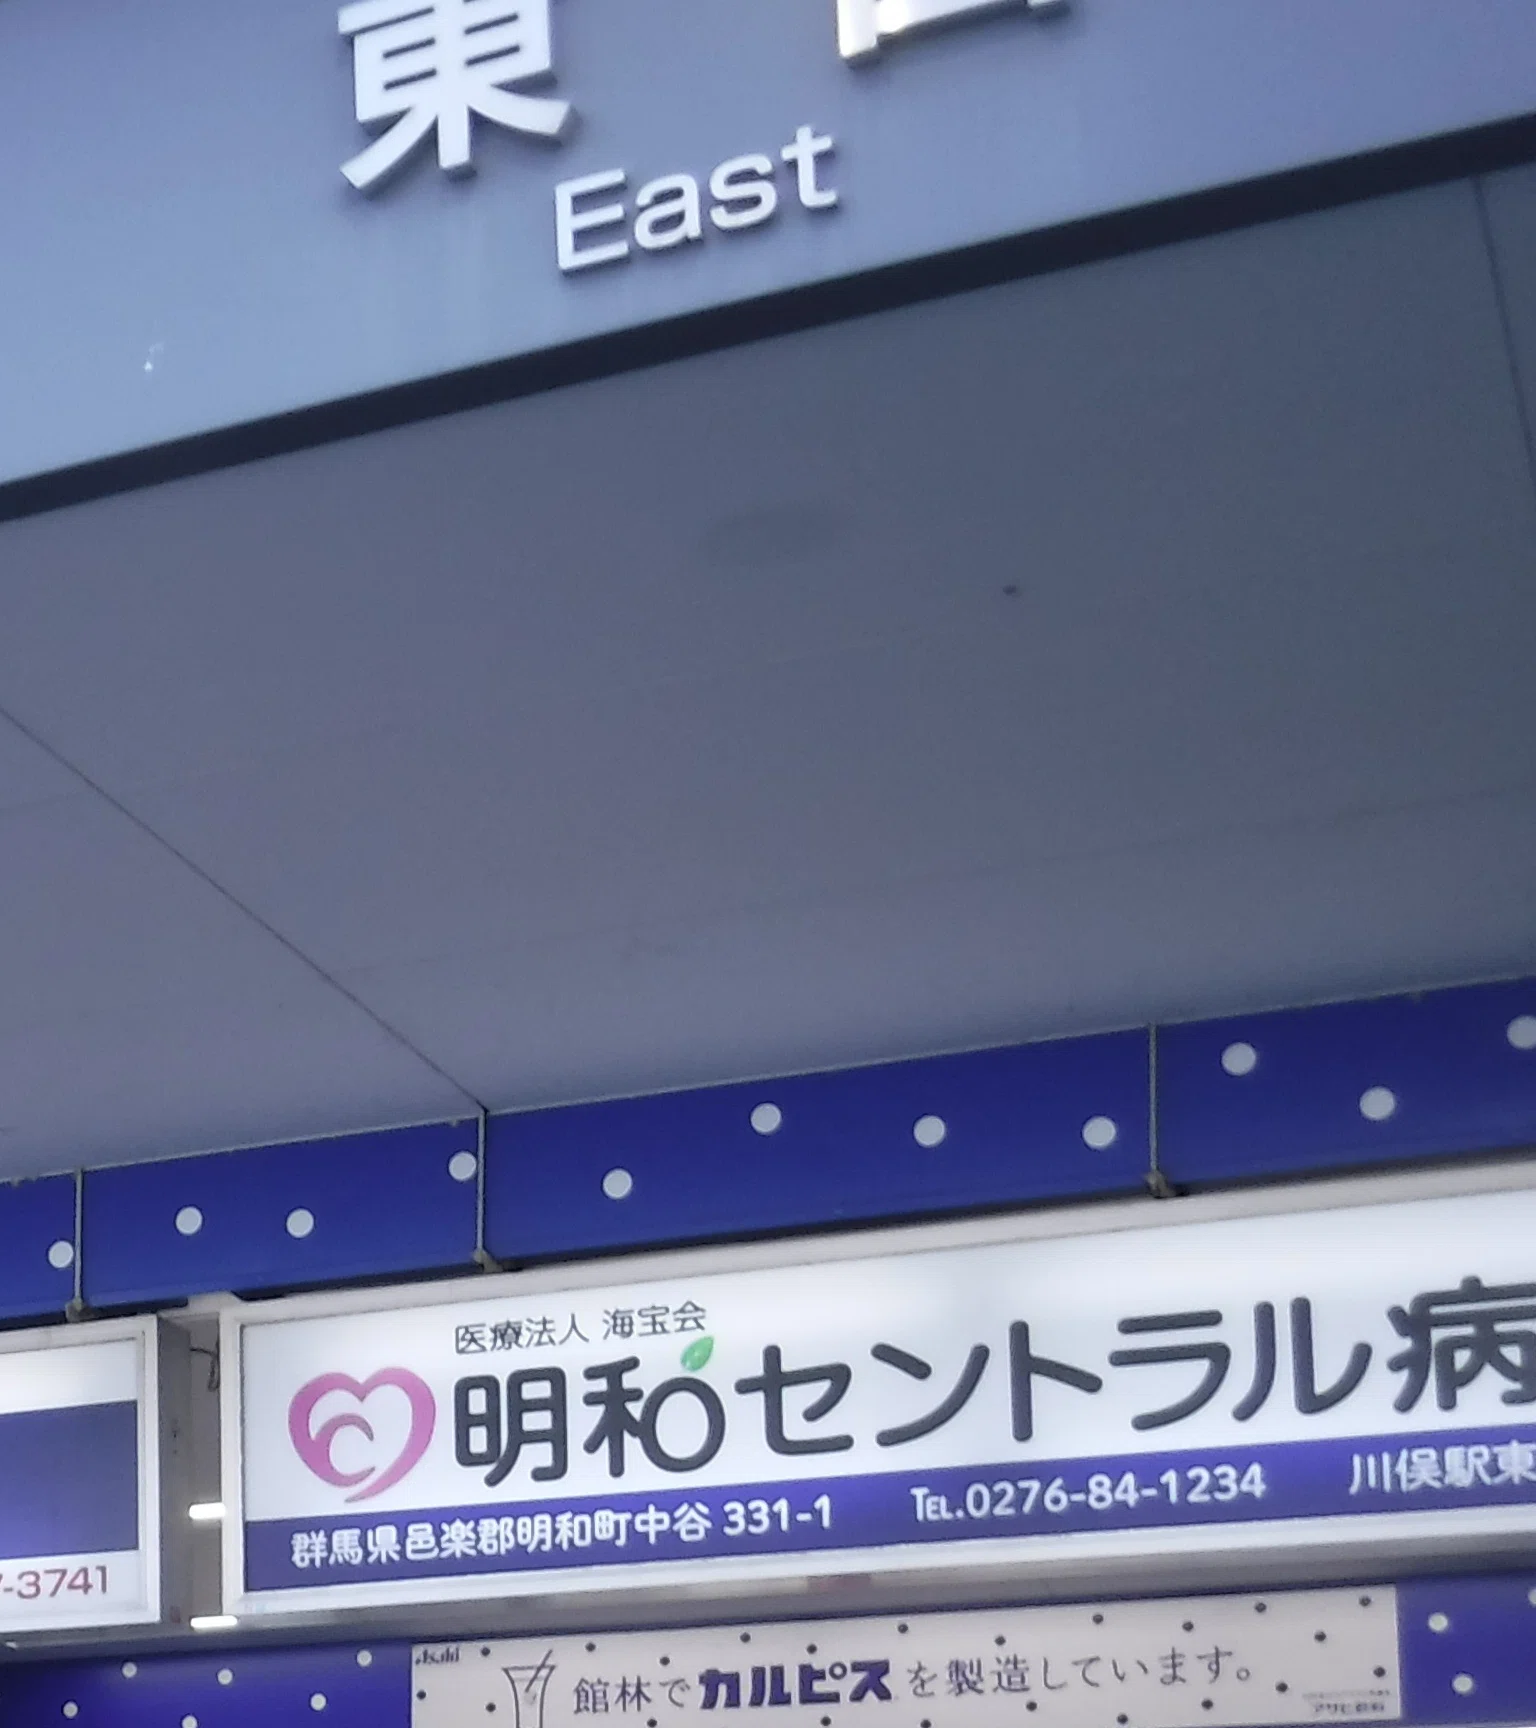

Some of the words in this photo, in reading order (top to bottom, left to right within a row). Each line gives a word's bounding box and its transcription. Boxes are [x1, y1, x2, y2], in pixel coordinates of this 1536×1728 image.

[553, 125, 838, 274] East
[453, 1275, 1536, 1488] 明和セントラル病
[455, 1312, 590, 1355] 医療法人
[602, 1300, 707, 1343] 海宝会
[290, 1502, 713, 1569] 群馬県邑楽郡明和町中谷
[723, 1494, 832, 1538] 331-1
[1349, 1440, 1536, 1497] 川俣駅東
[572, 1645, 1252, 1716] 館林でカルピスを製造しています。
